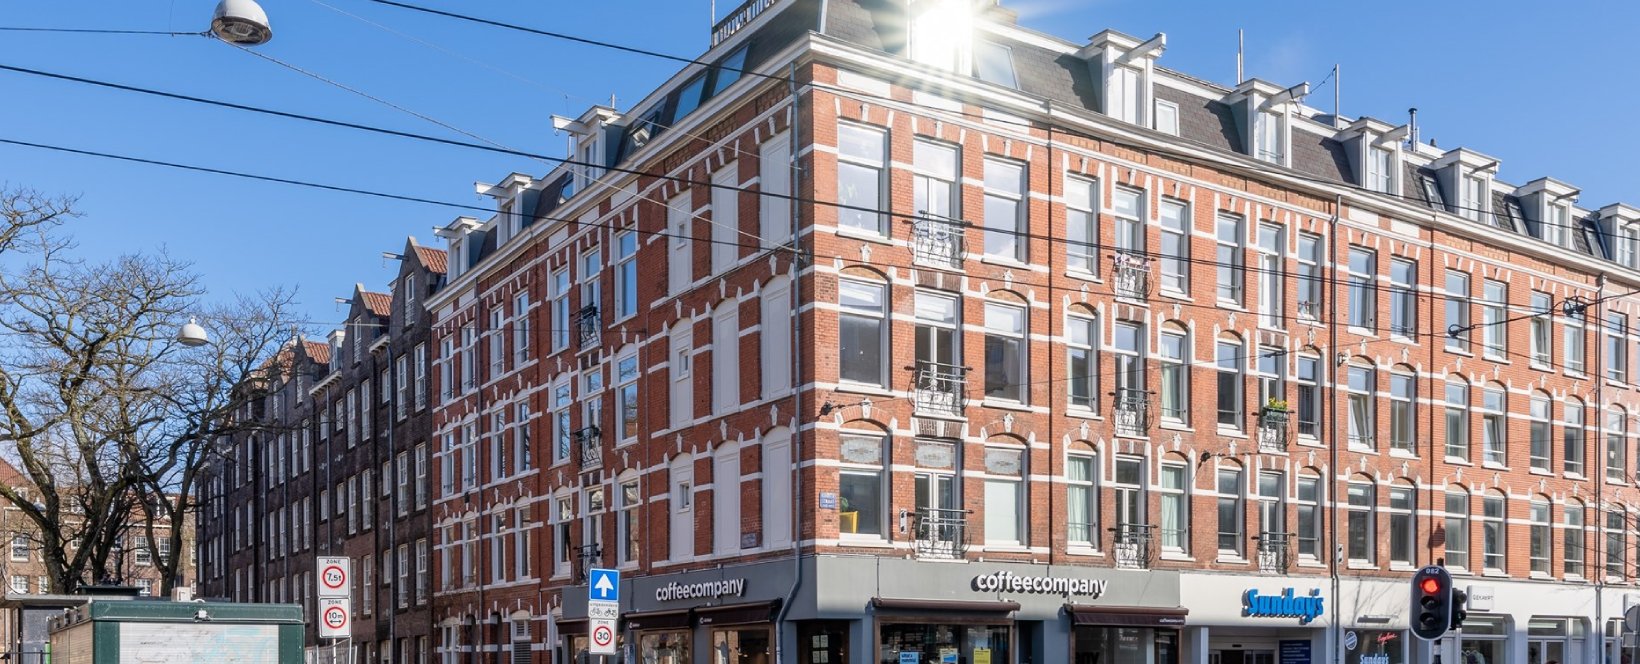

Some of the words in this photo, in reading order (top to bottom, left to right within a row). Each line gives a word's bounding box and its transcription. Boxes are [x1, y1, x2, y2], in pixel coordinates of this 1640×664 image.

[656, 578, 745, 601] coffeecompany
[976, 571, 1108, 597] coffeecompany
[1247, 588, 1324, 622] Sunday's
[597, 632, 609, 640] 30
